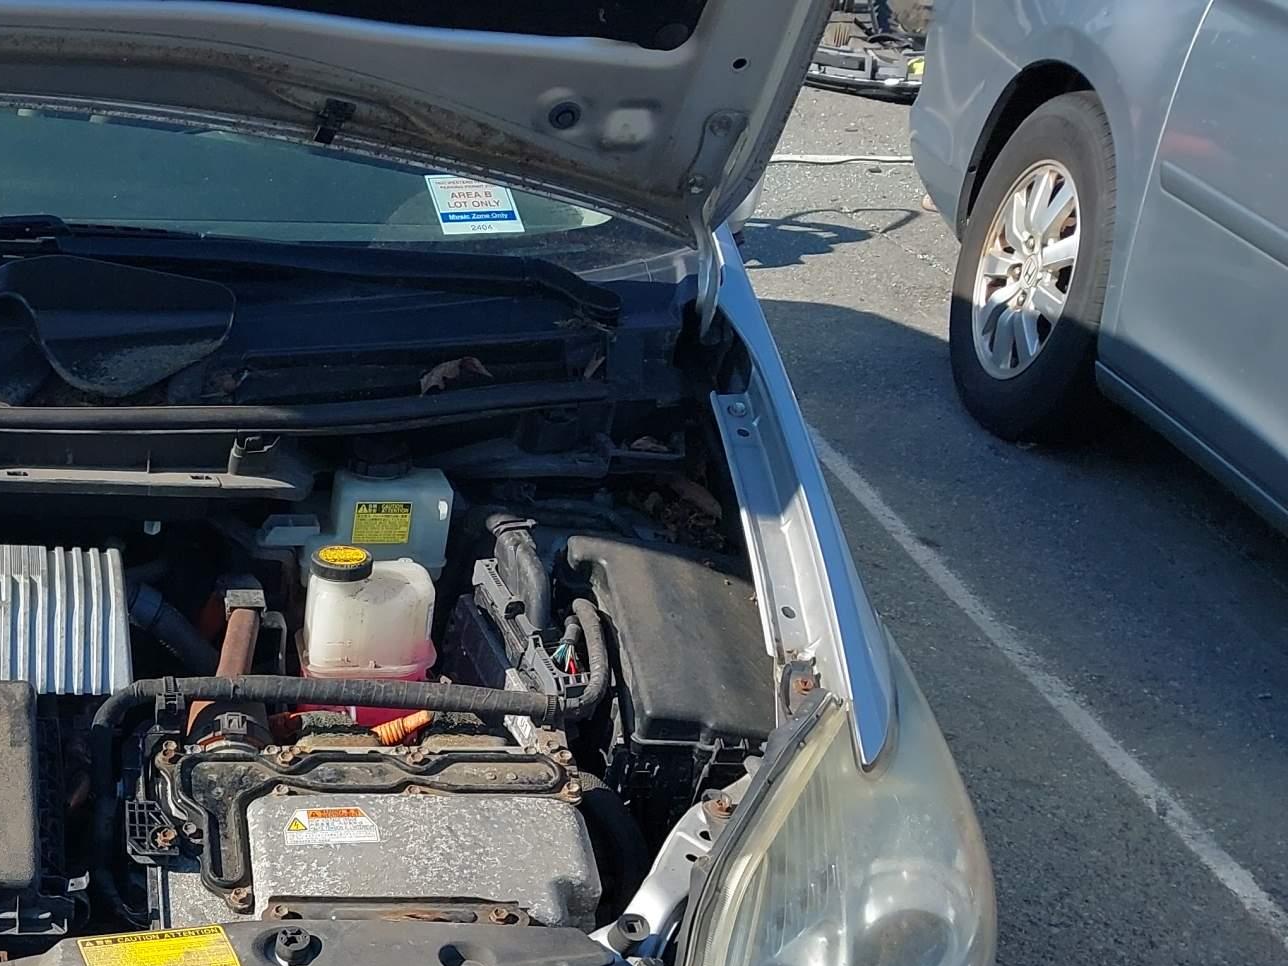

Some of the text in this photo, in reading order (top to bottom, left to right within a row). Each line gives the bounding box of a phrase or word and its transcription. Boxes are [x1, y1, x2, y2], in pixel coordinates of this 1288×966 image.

[451, 190, 492, 199] AREA B
[472, 200, 500, 208] ONLY
[116, 934, 159, 944] CAUTION
[163, 928, 219, 939] ATTENTION
